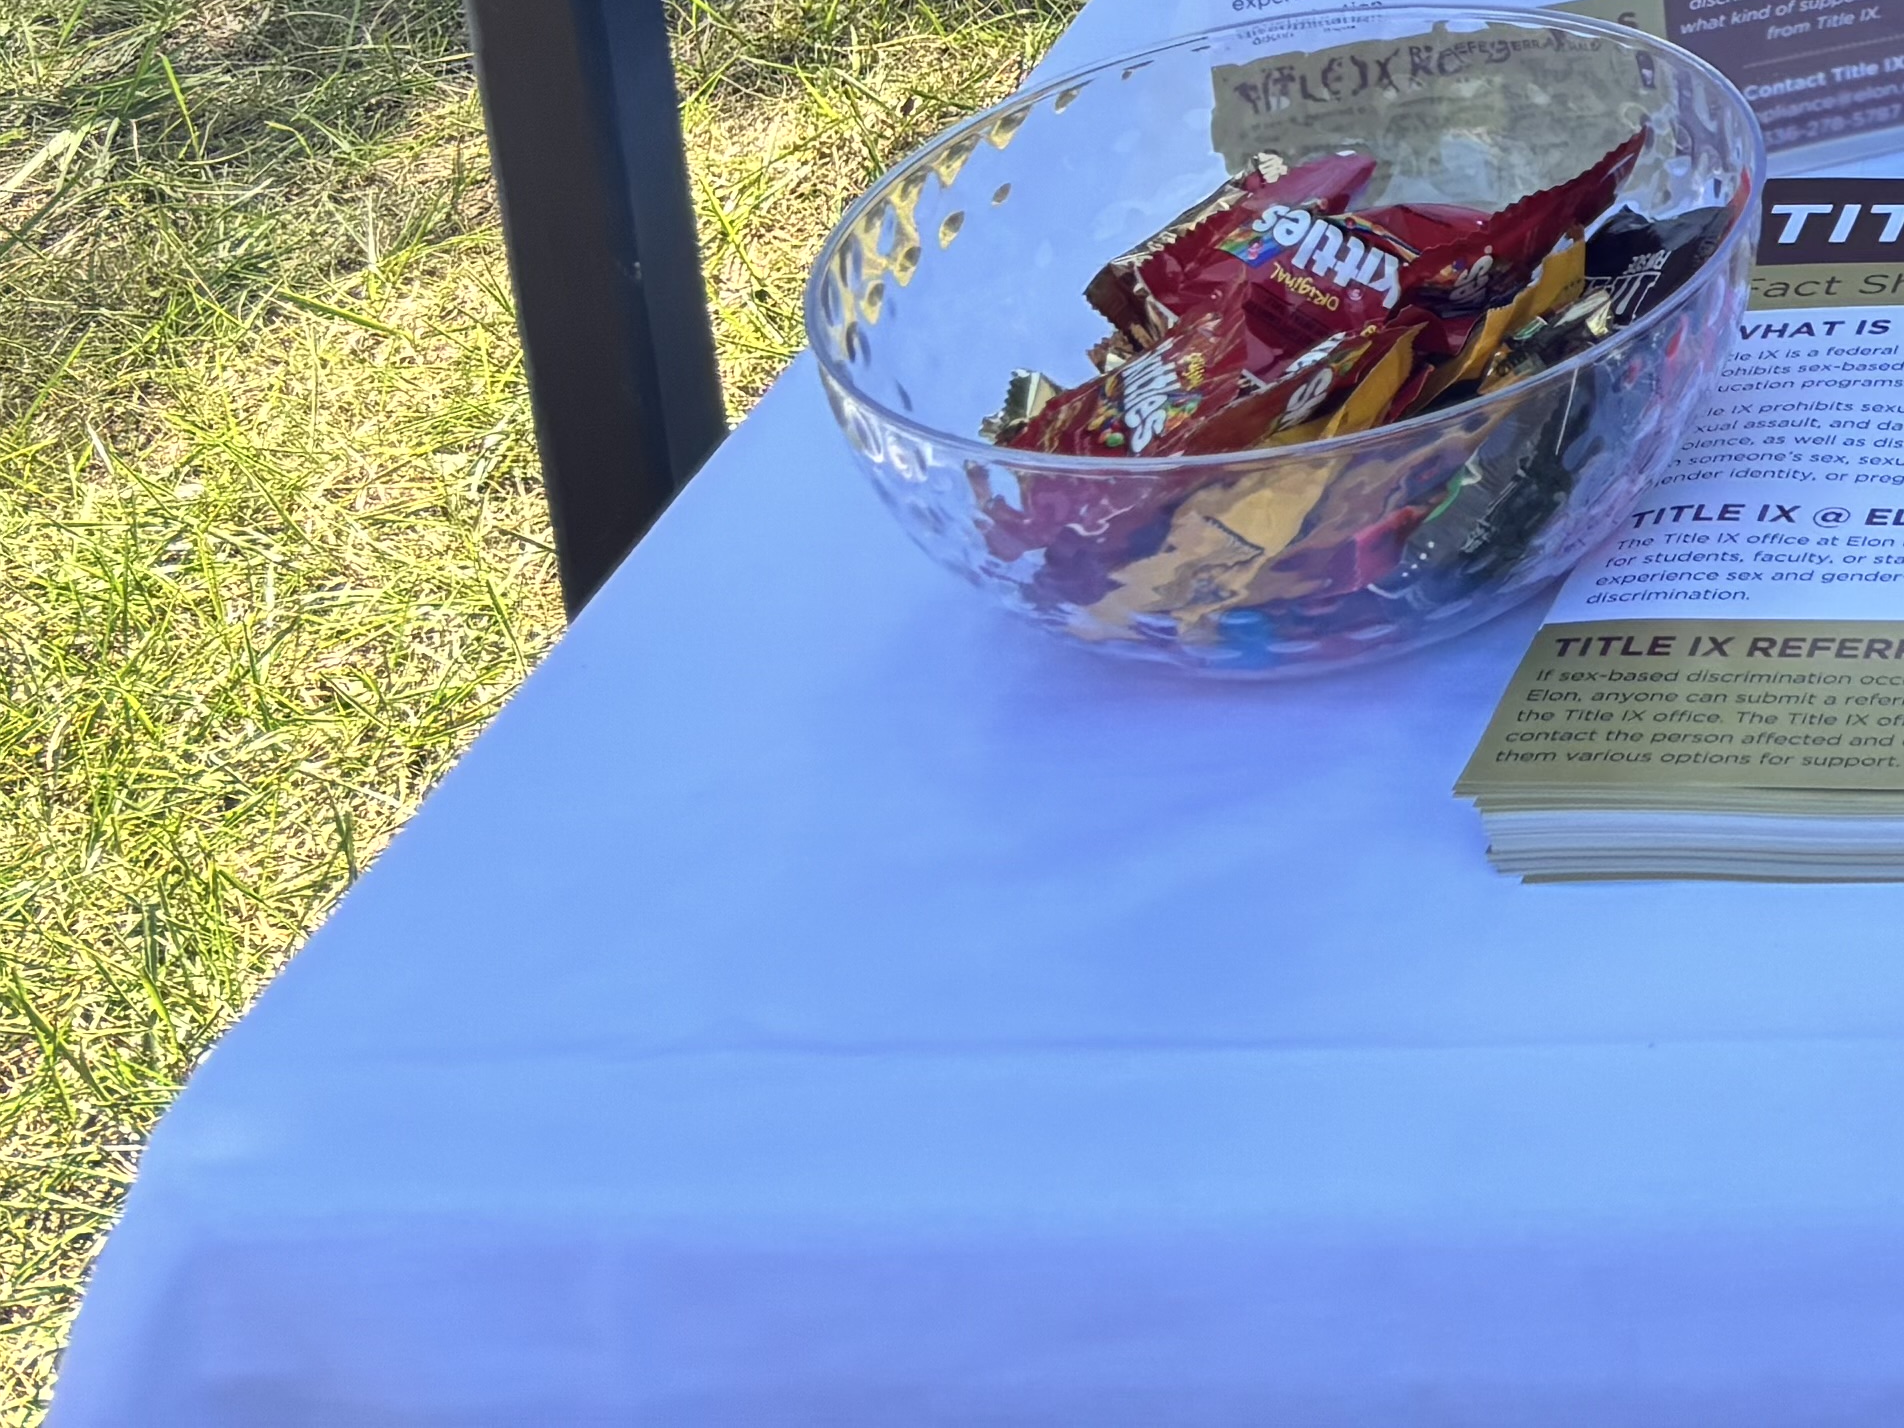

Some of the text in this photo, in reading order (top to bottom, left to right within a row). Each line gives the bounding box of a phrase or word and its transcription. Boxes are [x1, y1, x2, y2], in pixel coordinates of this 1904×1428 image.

[1554, 634, 1677, 657] TITLE
[1687, 635, 1736, 658] IX
[1535, 668, 1554, 681] If
[1557, 667, 1680, 683] sex-based
[1685, 669, 1852, 685] discrimination
[1525, 687, 1582, 703] Elon,
[1589, 690, 1679, 704] anyone
[1684, 692, 1728, 703] can
[1734, 690, 1817, 706] submit
[1822, 694, 1837, 706] a
[1515, 708, 1555, 722] the
[1564, 708, 1614, 722] Title
[1620, 708, 1647, 722] IX
[1651, 708, 1723, 724] office.
[1736, 710, 1779, 725] The
[1787, 711, 1838, 726] Title
[1844, 712, 1870, 726] IX
[1504, 728, 1598, 743] contact
[1604, 728, 1644, 743] the
[1649, 731, 1734, 745] person
[1740, 731, 1843, 746] affected
[1847, 733, 1896, 747] and
[1494, 748, 1900, 769] them various options for support.
